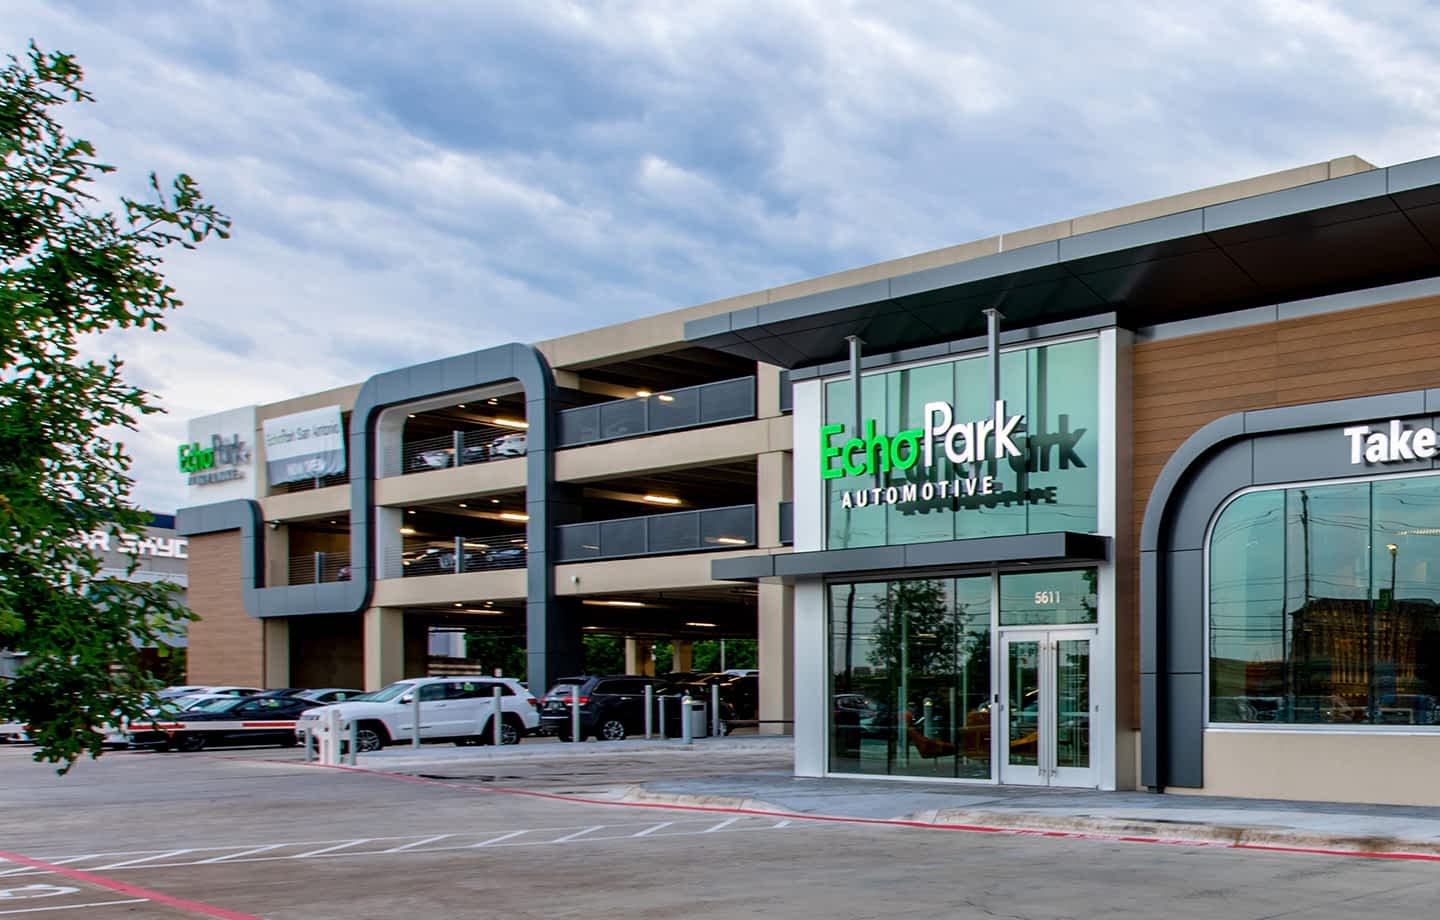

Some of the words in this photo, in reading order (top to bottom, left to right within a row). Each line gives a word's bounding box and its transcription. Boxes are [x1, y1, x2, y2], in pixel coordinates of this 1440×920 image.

[820, 400, 1023, 480] EchoPark
[1344, 420, 1438, 464] Take
[841, 476, 994, 509] AUTOMOTIVE
[1034, 591, 1061, 604] 5611
